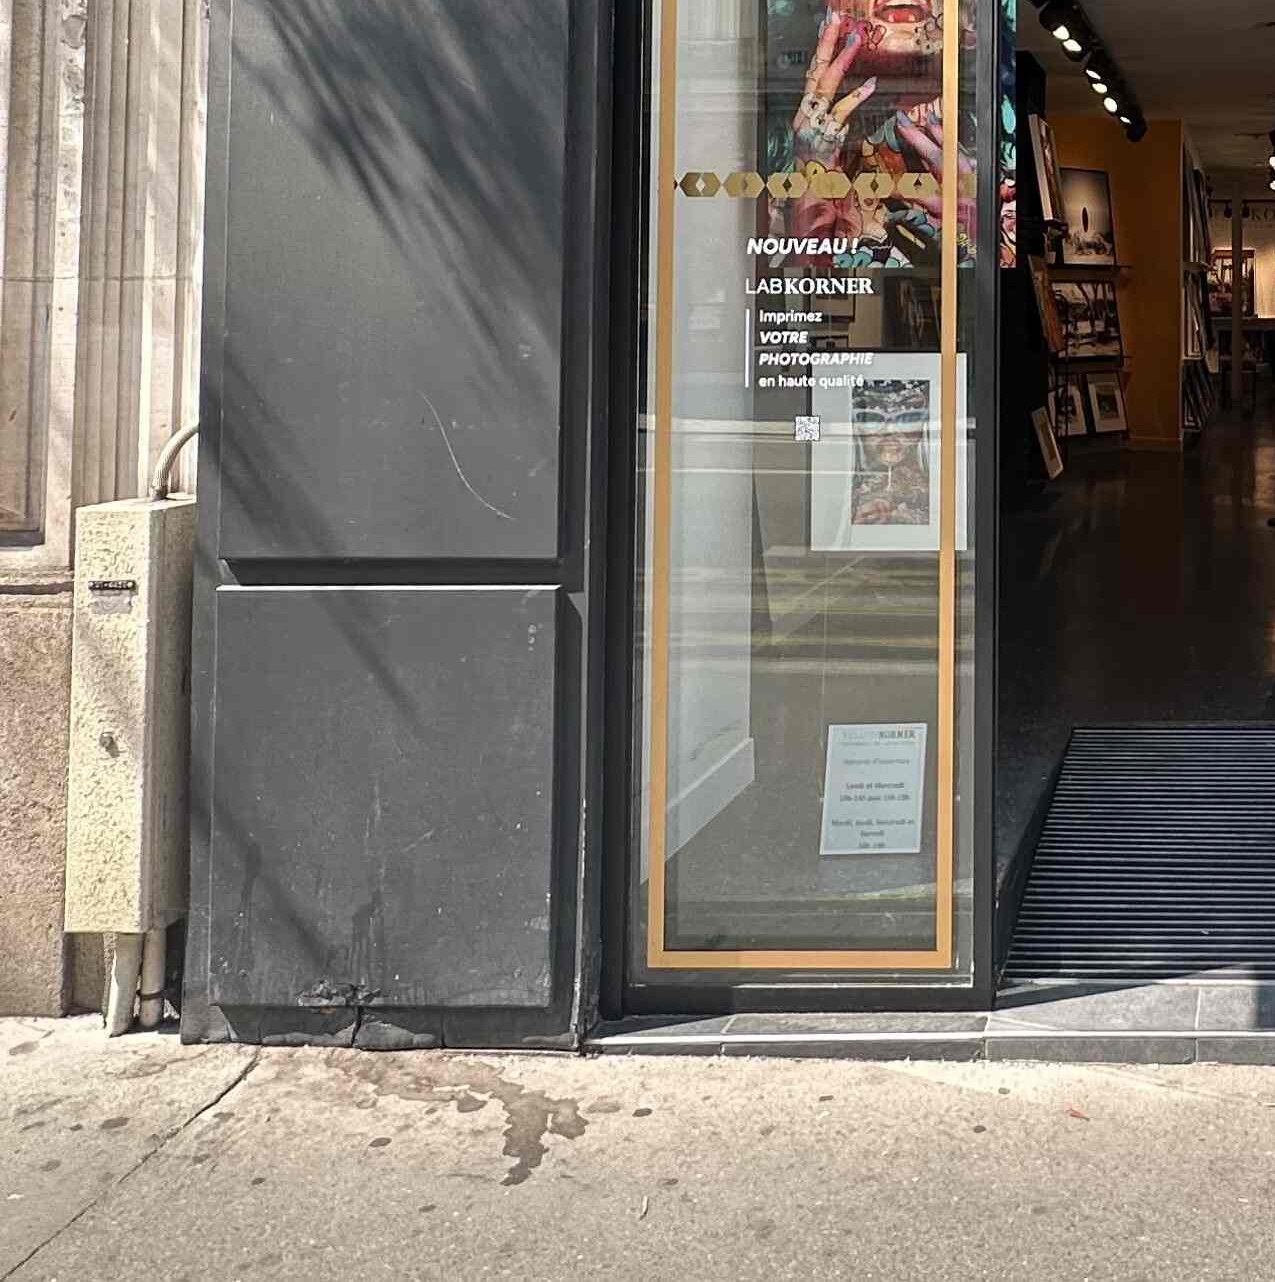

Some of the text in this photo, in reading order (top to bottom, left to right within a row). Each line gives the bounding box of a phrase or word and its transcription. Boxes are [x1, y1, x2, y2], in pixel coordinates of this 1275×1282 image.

[747, 238, 848, 255] NOUVEAU
[745, 277, 874, 295] LABKORNER
[759, 309, 823, 324] Imprimez
[759, 331, 809, 345] VOTRE
[758, 352, 875, 366] PHOTOGRAPHIE
[758, 374, 865, 389] en haute qualité
